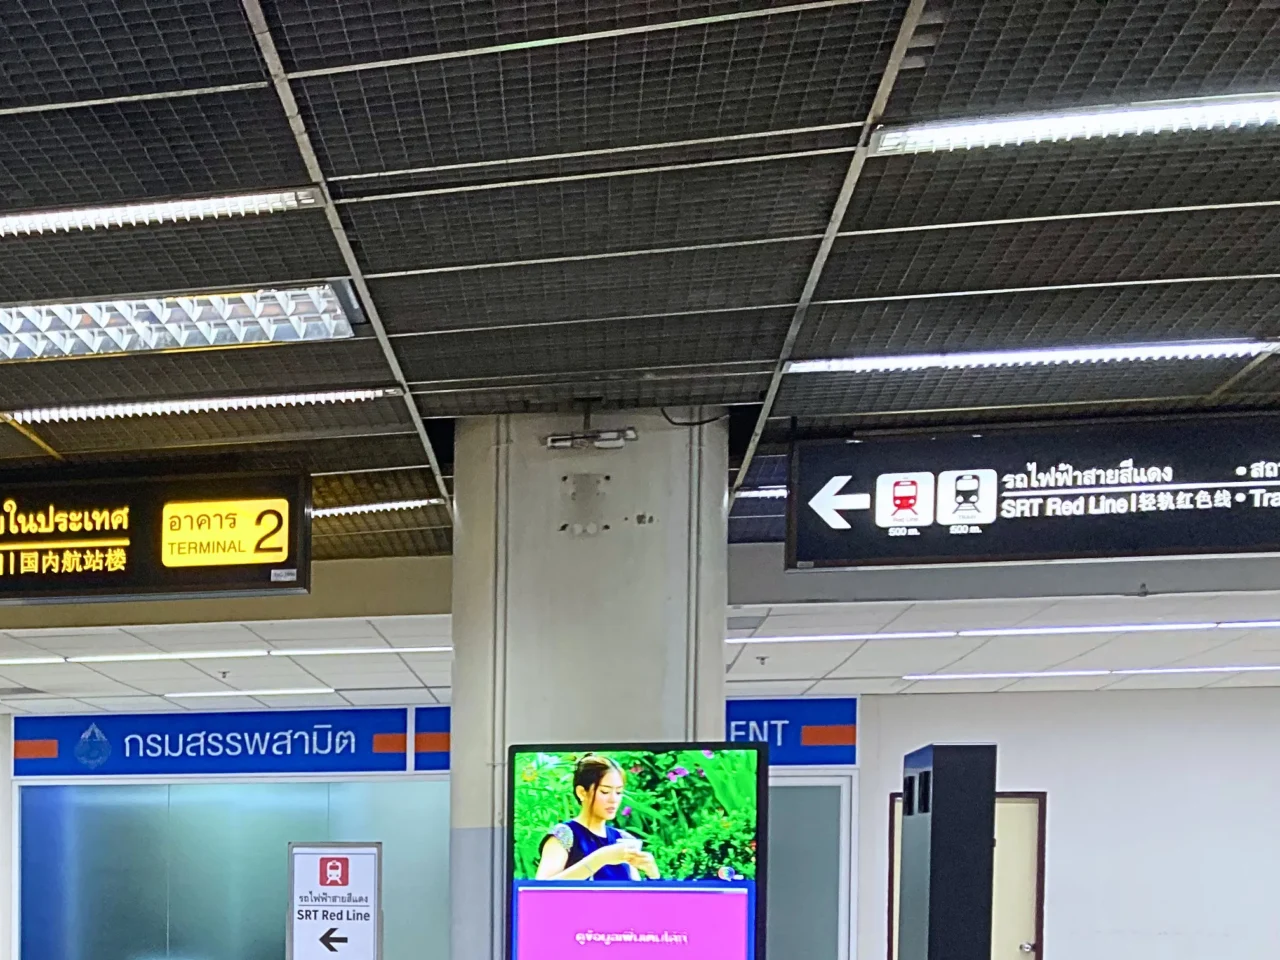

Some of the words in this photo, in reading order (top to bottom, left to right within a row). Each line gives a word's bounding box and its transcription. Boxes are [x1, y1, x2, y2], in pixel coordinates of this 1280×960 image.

[1001, 458, 1173, 489] รถไฟฟ้าสายสีแดง
[1001, 497, 1044, 518] SRT
[1045, 496, 1085, 516] Red
[1088, 494, 1129, 515] Line
[168, 512, 238, 532] อาคาร
[253, 508, 284, 554] 2
[167, 540, 247, 556] TERMINAL
[20, 548, 127, 575] 国内航站楼
[124, 724, 356, 757] กรมสรรพสามิต
[297, 909, 319, 921] SRT
[321, 909, 344, 921] Red
[346, 909, 371, 922] Line
